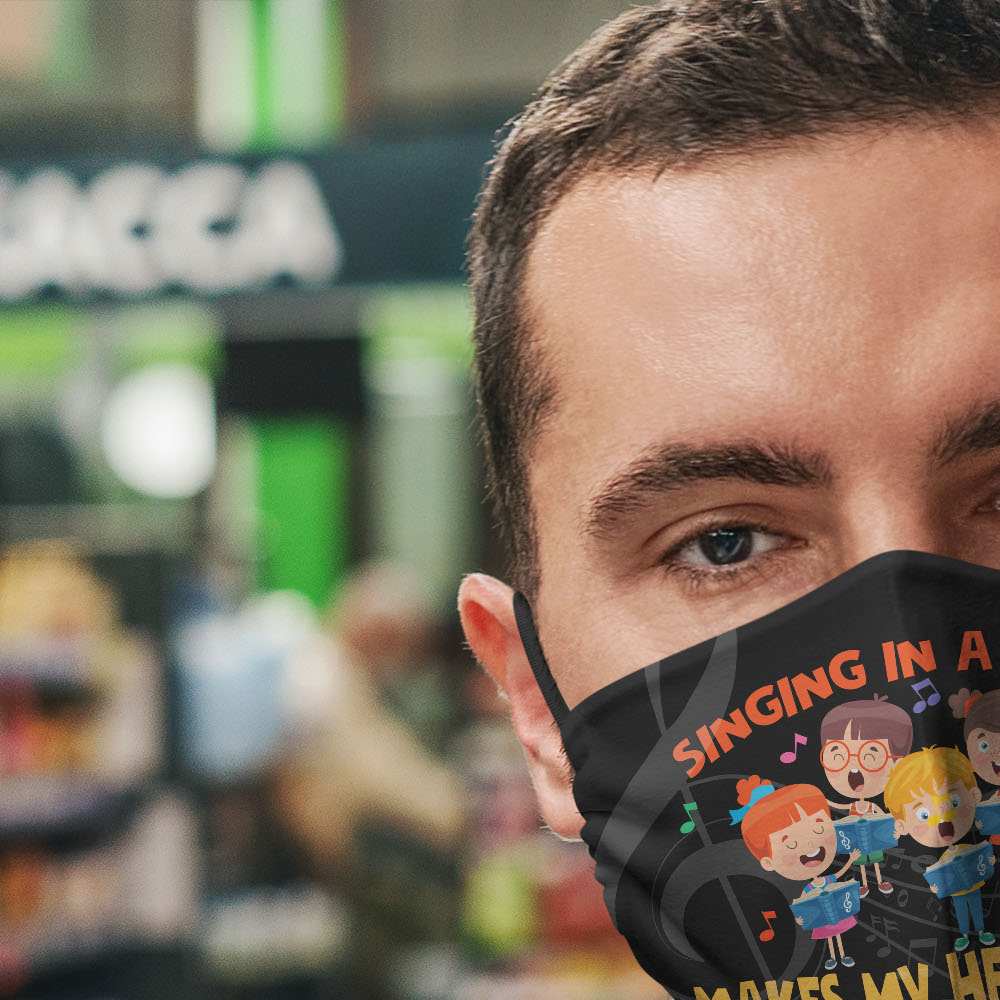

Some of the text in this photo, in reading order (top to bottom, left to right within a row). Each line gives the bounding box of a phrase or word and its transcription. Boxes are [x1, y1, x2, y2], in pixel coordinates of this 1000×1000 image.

[672, 649, 867, 779] SINGING
[881, 639, 937, 683] IN
[957, 630, 993, 672] A
